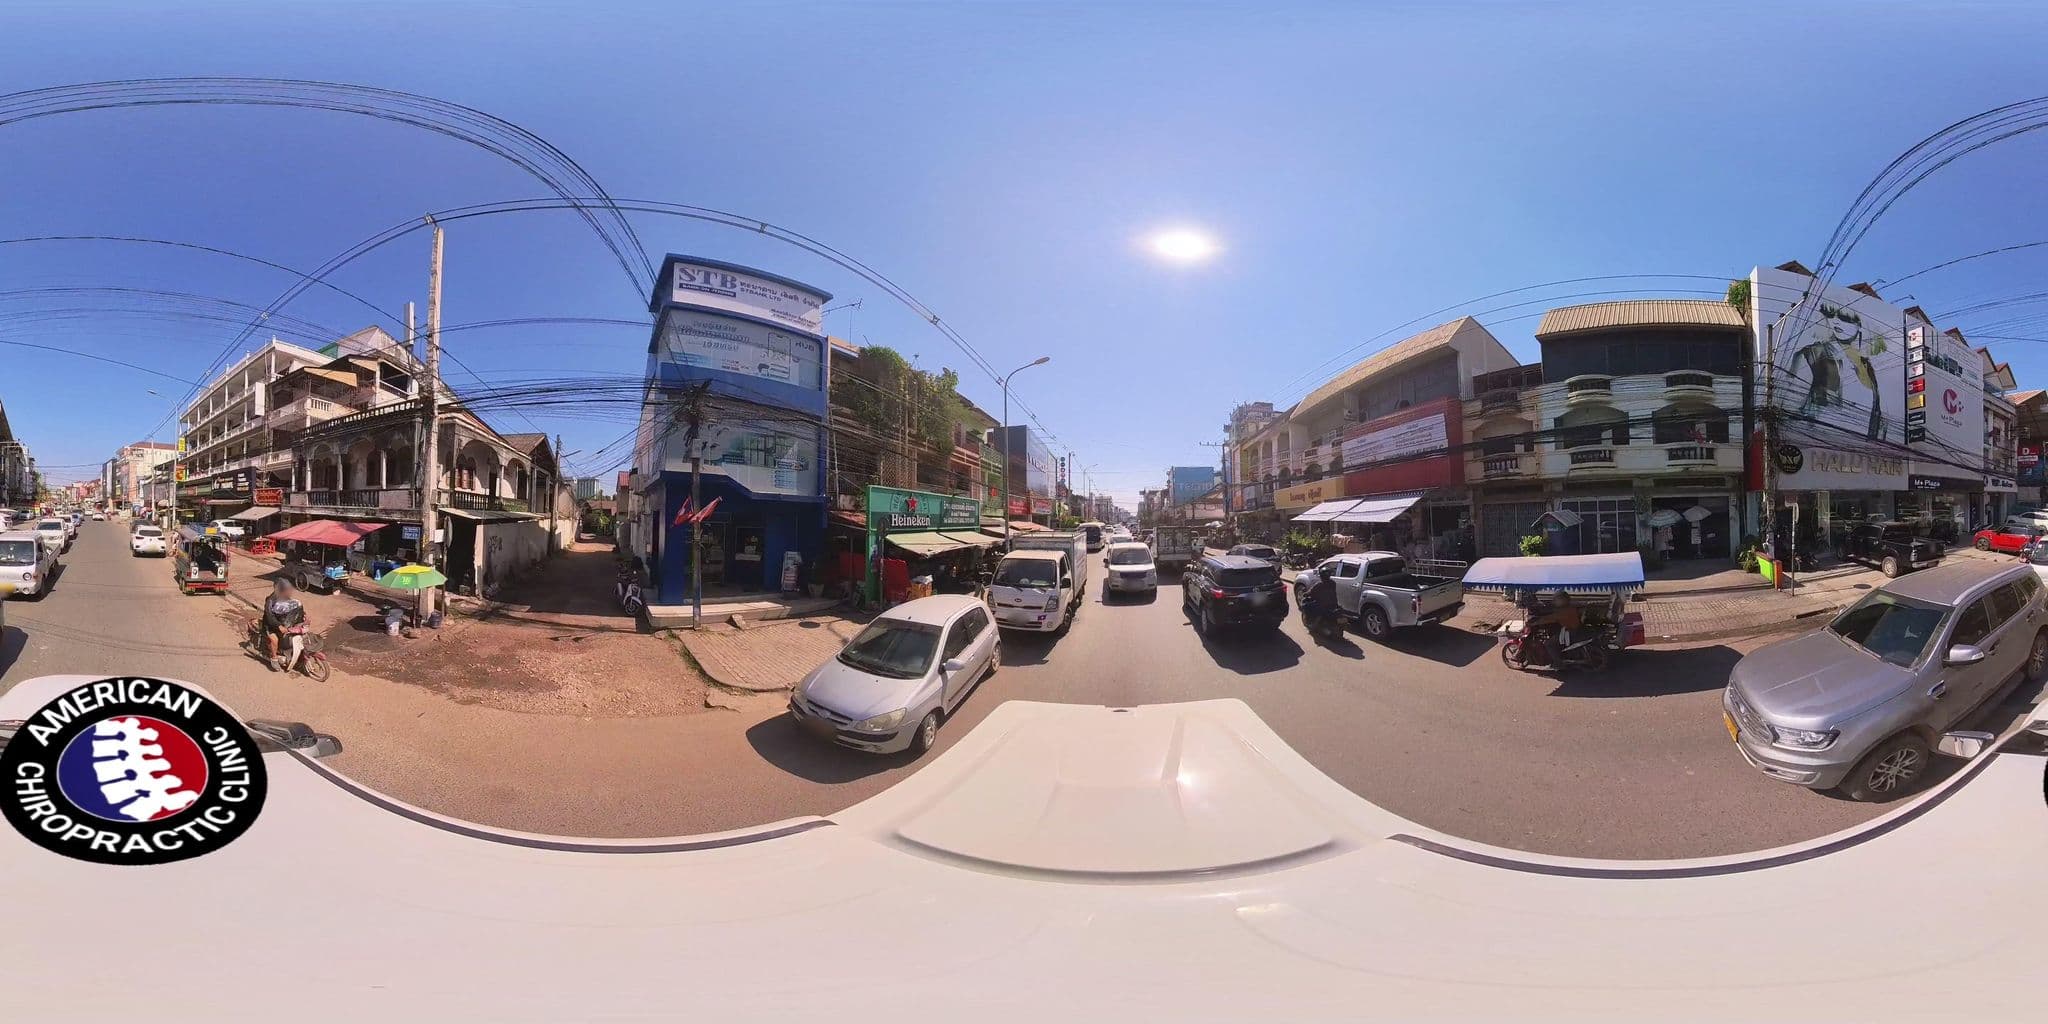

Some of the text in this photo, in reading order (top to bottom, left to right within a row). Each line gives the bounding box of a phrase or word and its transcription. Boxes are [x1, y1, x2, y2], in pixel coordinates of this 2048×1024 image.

[679, 267, 737, 290] STB
[740, 287, 769, 299] STBANK
[1863, 455, 1904, 476] HAIR
[1924, 479, 1941, 487] Plaza
[891, 513, 931, 526] Heineken
